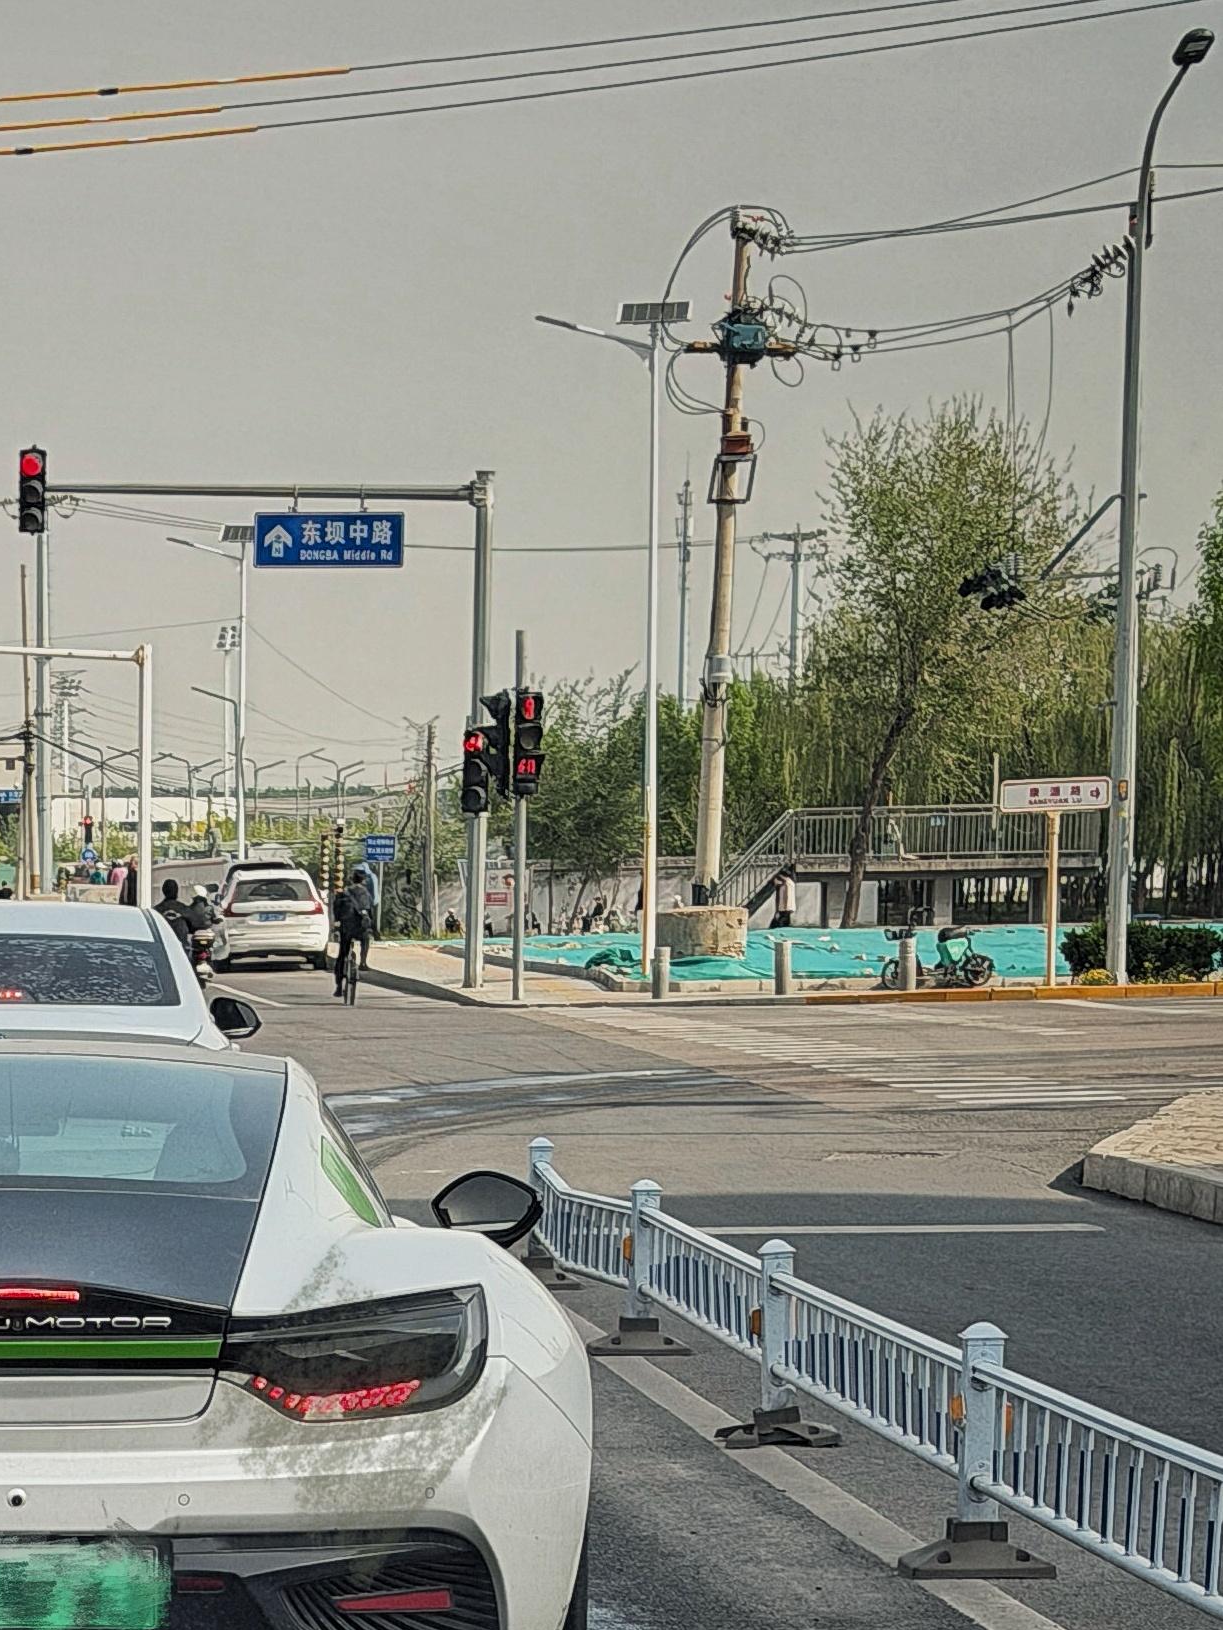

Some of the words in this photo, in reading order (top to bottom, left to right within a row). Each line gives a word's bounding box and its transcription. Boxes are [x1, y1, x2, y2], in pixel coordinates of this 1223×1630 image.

[301, 520, 393, 545] 东坝中路
[299, 549, 338, 560] DONGBA
[343, 549, 376, 560] Middle
[380, 549, 393, 560] Rd
[24, 1315, 172, 1330] MOTOR
